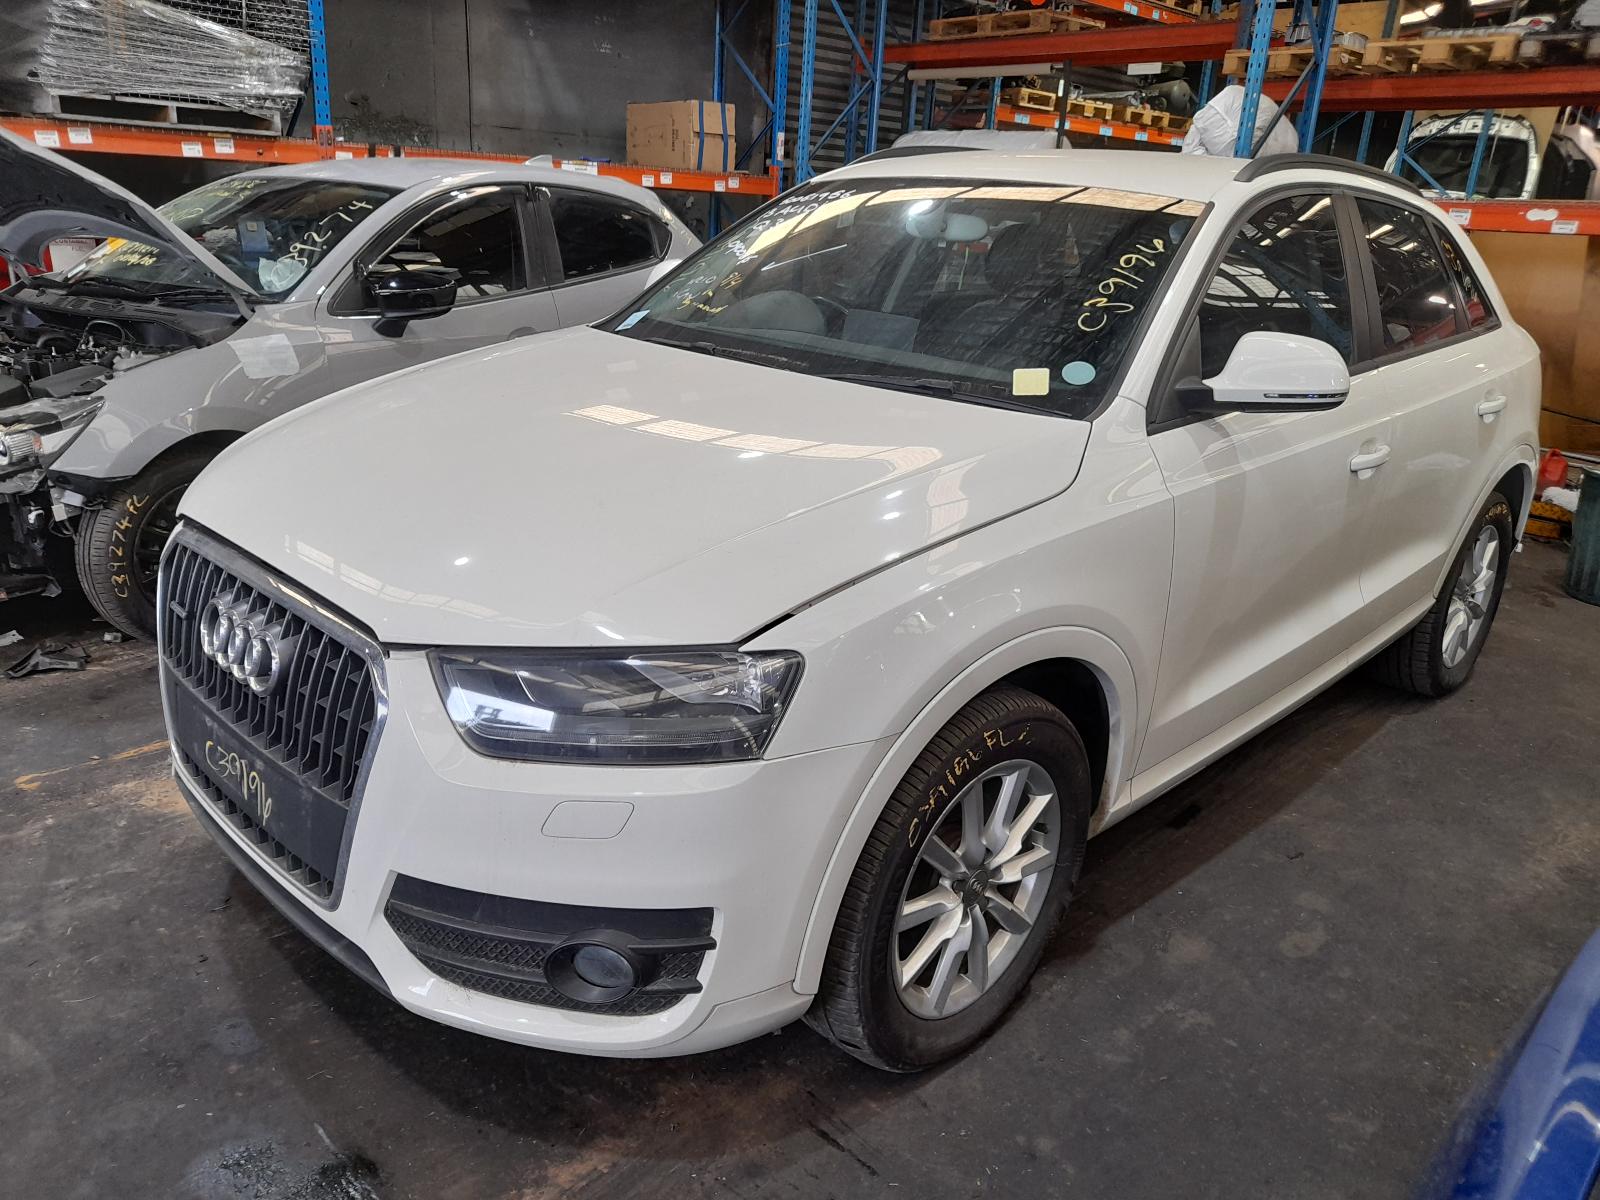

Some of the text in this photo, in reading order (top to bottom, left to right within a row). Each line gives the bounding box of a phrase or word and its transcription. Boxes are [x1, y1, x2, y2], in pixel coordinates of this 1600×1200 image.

[1077, 238, 1165, 332] C39196
[108, 516, 133, 598] C39274
[205, 740, 273, 827] C39196
